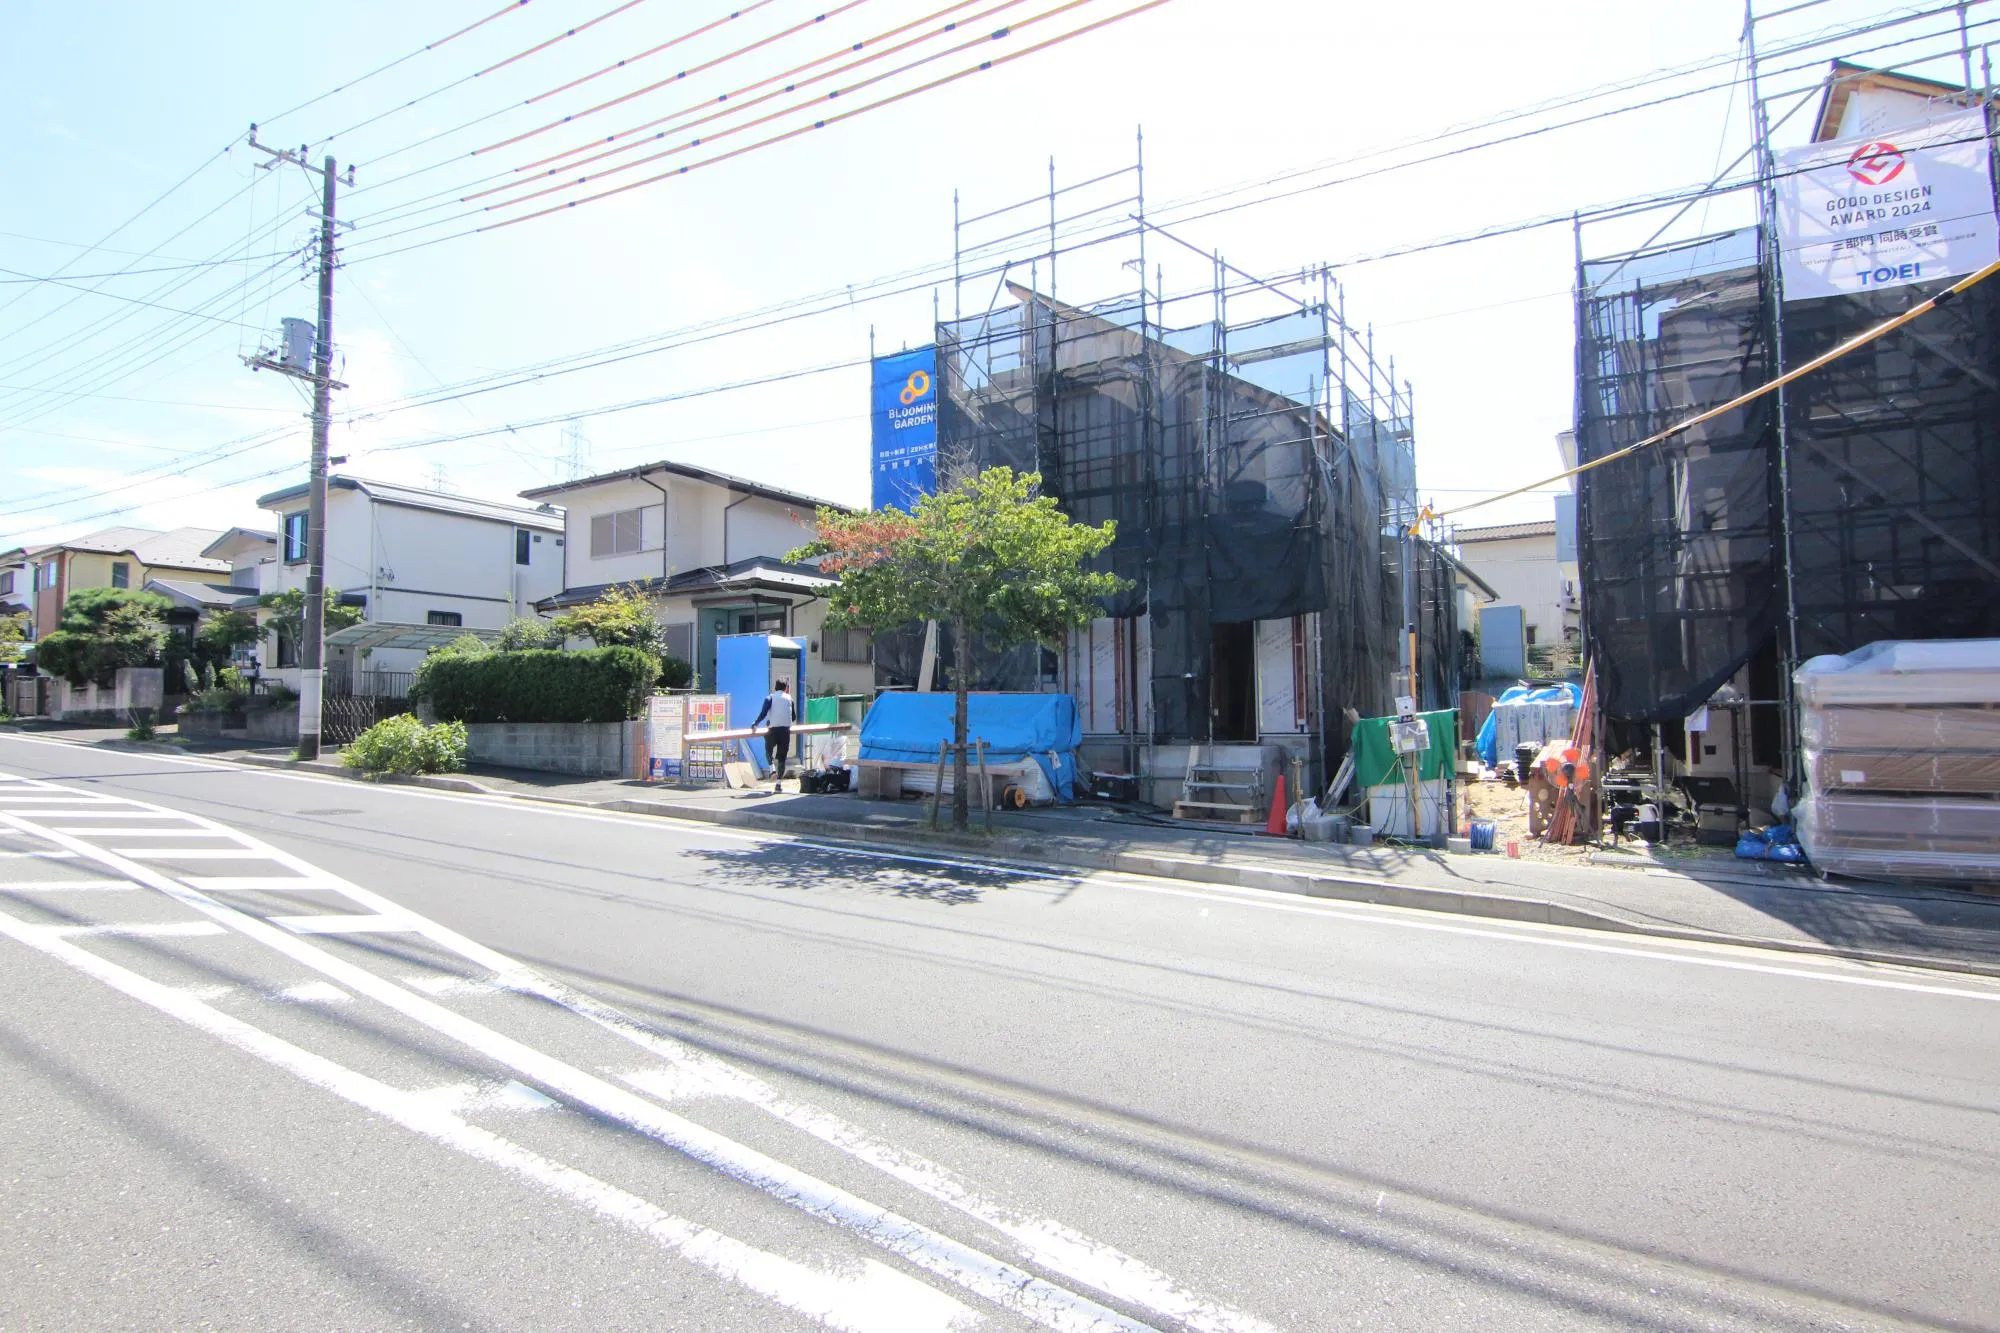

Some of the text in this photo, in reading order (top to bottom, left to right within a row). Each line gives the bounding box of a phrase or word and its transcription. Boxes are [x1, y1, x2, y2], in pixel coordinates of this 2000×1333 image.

[1826, 185, 1932, 212] GOOD DESIGN
[1830, 201, 1932, 227] AWARD 2024
[888, 403, 936, 419] BLOOMIN
[894, 414, 934, 430] GARDEN
